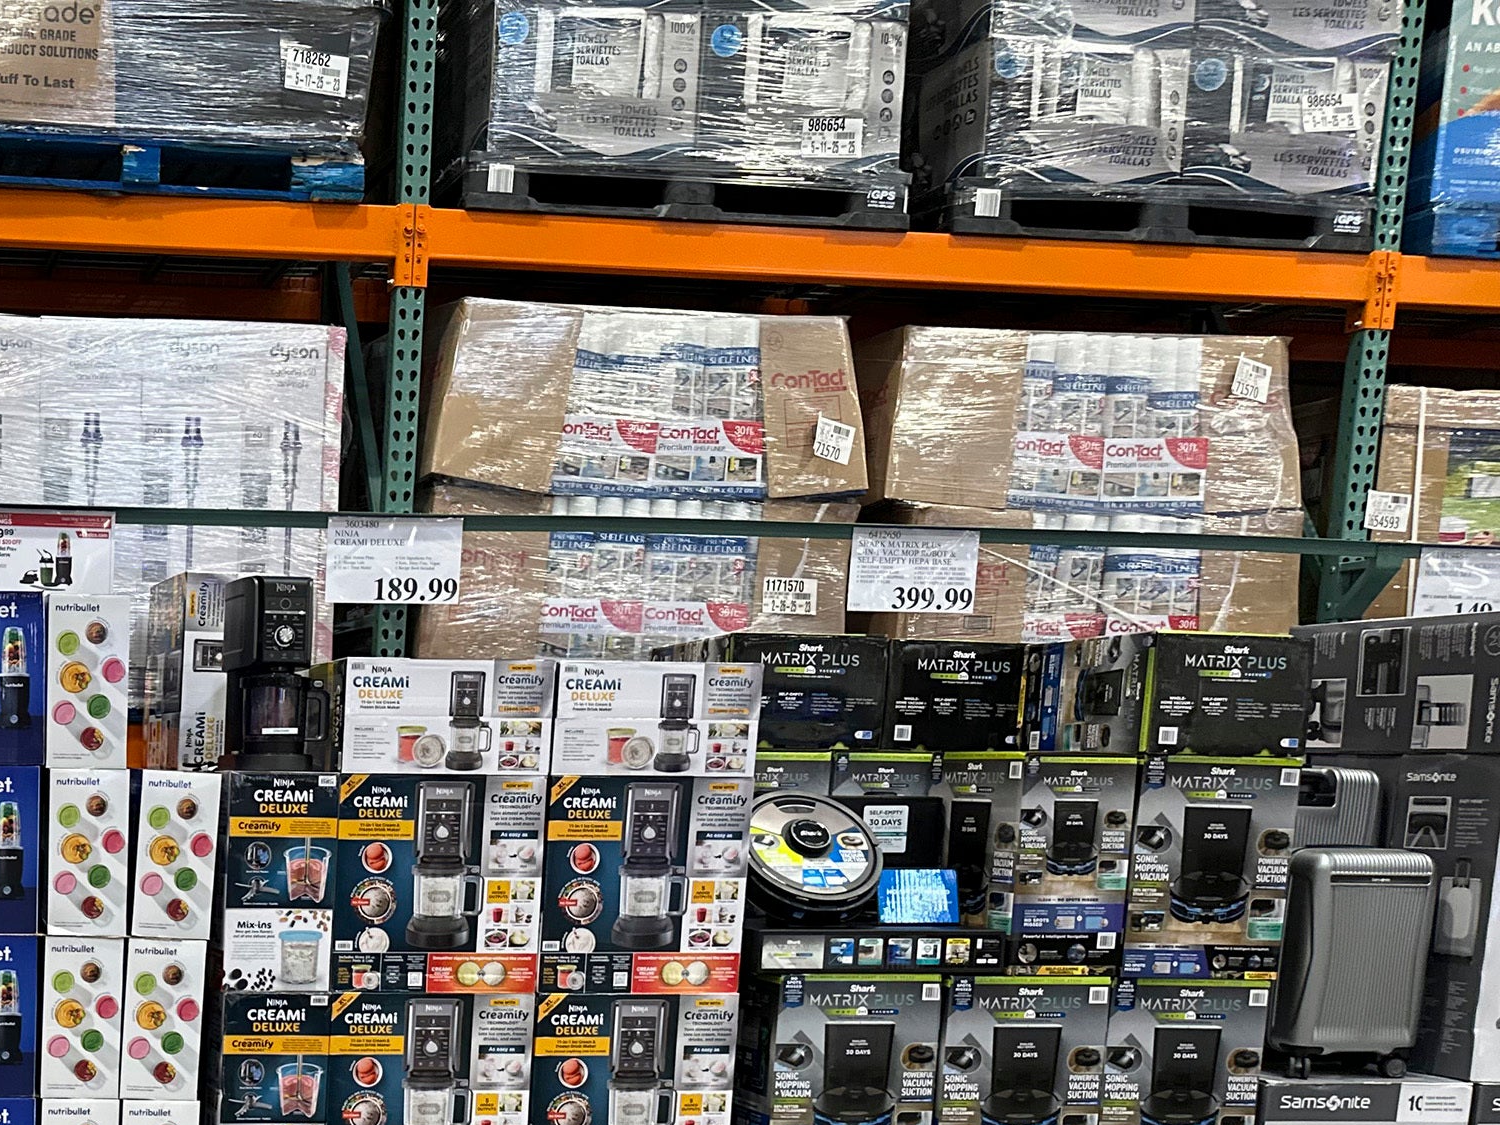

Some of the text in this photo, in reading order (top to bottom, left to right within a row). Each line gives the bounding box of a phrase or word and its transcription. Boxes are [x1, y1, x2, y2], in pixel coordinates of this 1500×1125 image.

[670, 22, 696, 35] 100%
[40, 29, 77, 42] GRADE
[39, 46, 99, 60] SOLUTIONS
[292, 47, 331, 68] 718262
[576, 56, 610, 66] TOALLAS
[23, 75, 39, 87] To
[44, 76, 75, 89] Last
[332, 78, 341, 91] 23
[1080, 88, 1112, 99] TOALLAS
[1307, 95, 1343, 108] 986654
[808, 118, 846, 132] 986654
[613, 126, 656, 138] TOALLAS
[1306, 166, 1348, 178] TOALLAS
[270, 344, 319, 361] dyson
[1236, 380, 1259, 398] 71570
[815, 442, 841, 460] 71570
[344, 519, 380, 528] 3603480
[334, 529, 360, 537] NINJA
[334, 538, 405, 547] CREAMI DELUXE
[888, 540, 919, 549] MATRIX
[882, 549, 920, 557] VAC MOP
[857, 556, 953, 566] SELF-EMPTY HEPA BASE
[373, 577, 458, 602] 189.99
[765, 579, 804, 593] 1171570
[891, 586, 973, 611] 399.99
[798, 644, 824, 655] Shark
[1224, 644, 1250, 655] Shark
[761, 653, 860, 667] MATRIX PLUS
[1185, 654, 1287, 670] MATRIX PLUS
[498, 674, 545, 687] Creamify
[359, 689, 403, 699] DELUXE
[1406, 771, 1457, 784] Samsonite
[259, 803, 308, 815] DELUXE
[238, 821, 282, 833] Creamify
[237, 920, 272, 930] Mix-ins
[850, 984, 876, 994] Shark
[809, 993, 915, 1007] MATRIX PLUS
[775, 1071, 799, 1081] SONIC
[902, 1071, 933, 1079] POWERFUL
[775, 1080, 811, 1090] MOPPING
[902, 1078, 933, 1088] VACUUM
[780, 1089, 812, 1098] VACUUM
[901, 1088, 932, 1097] SUCTION
[1280, 1094, 1371, 1111] Samsonite
